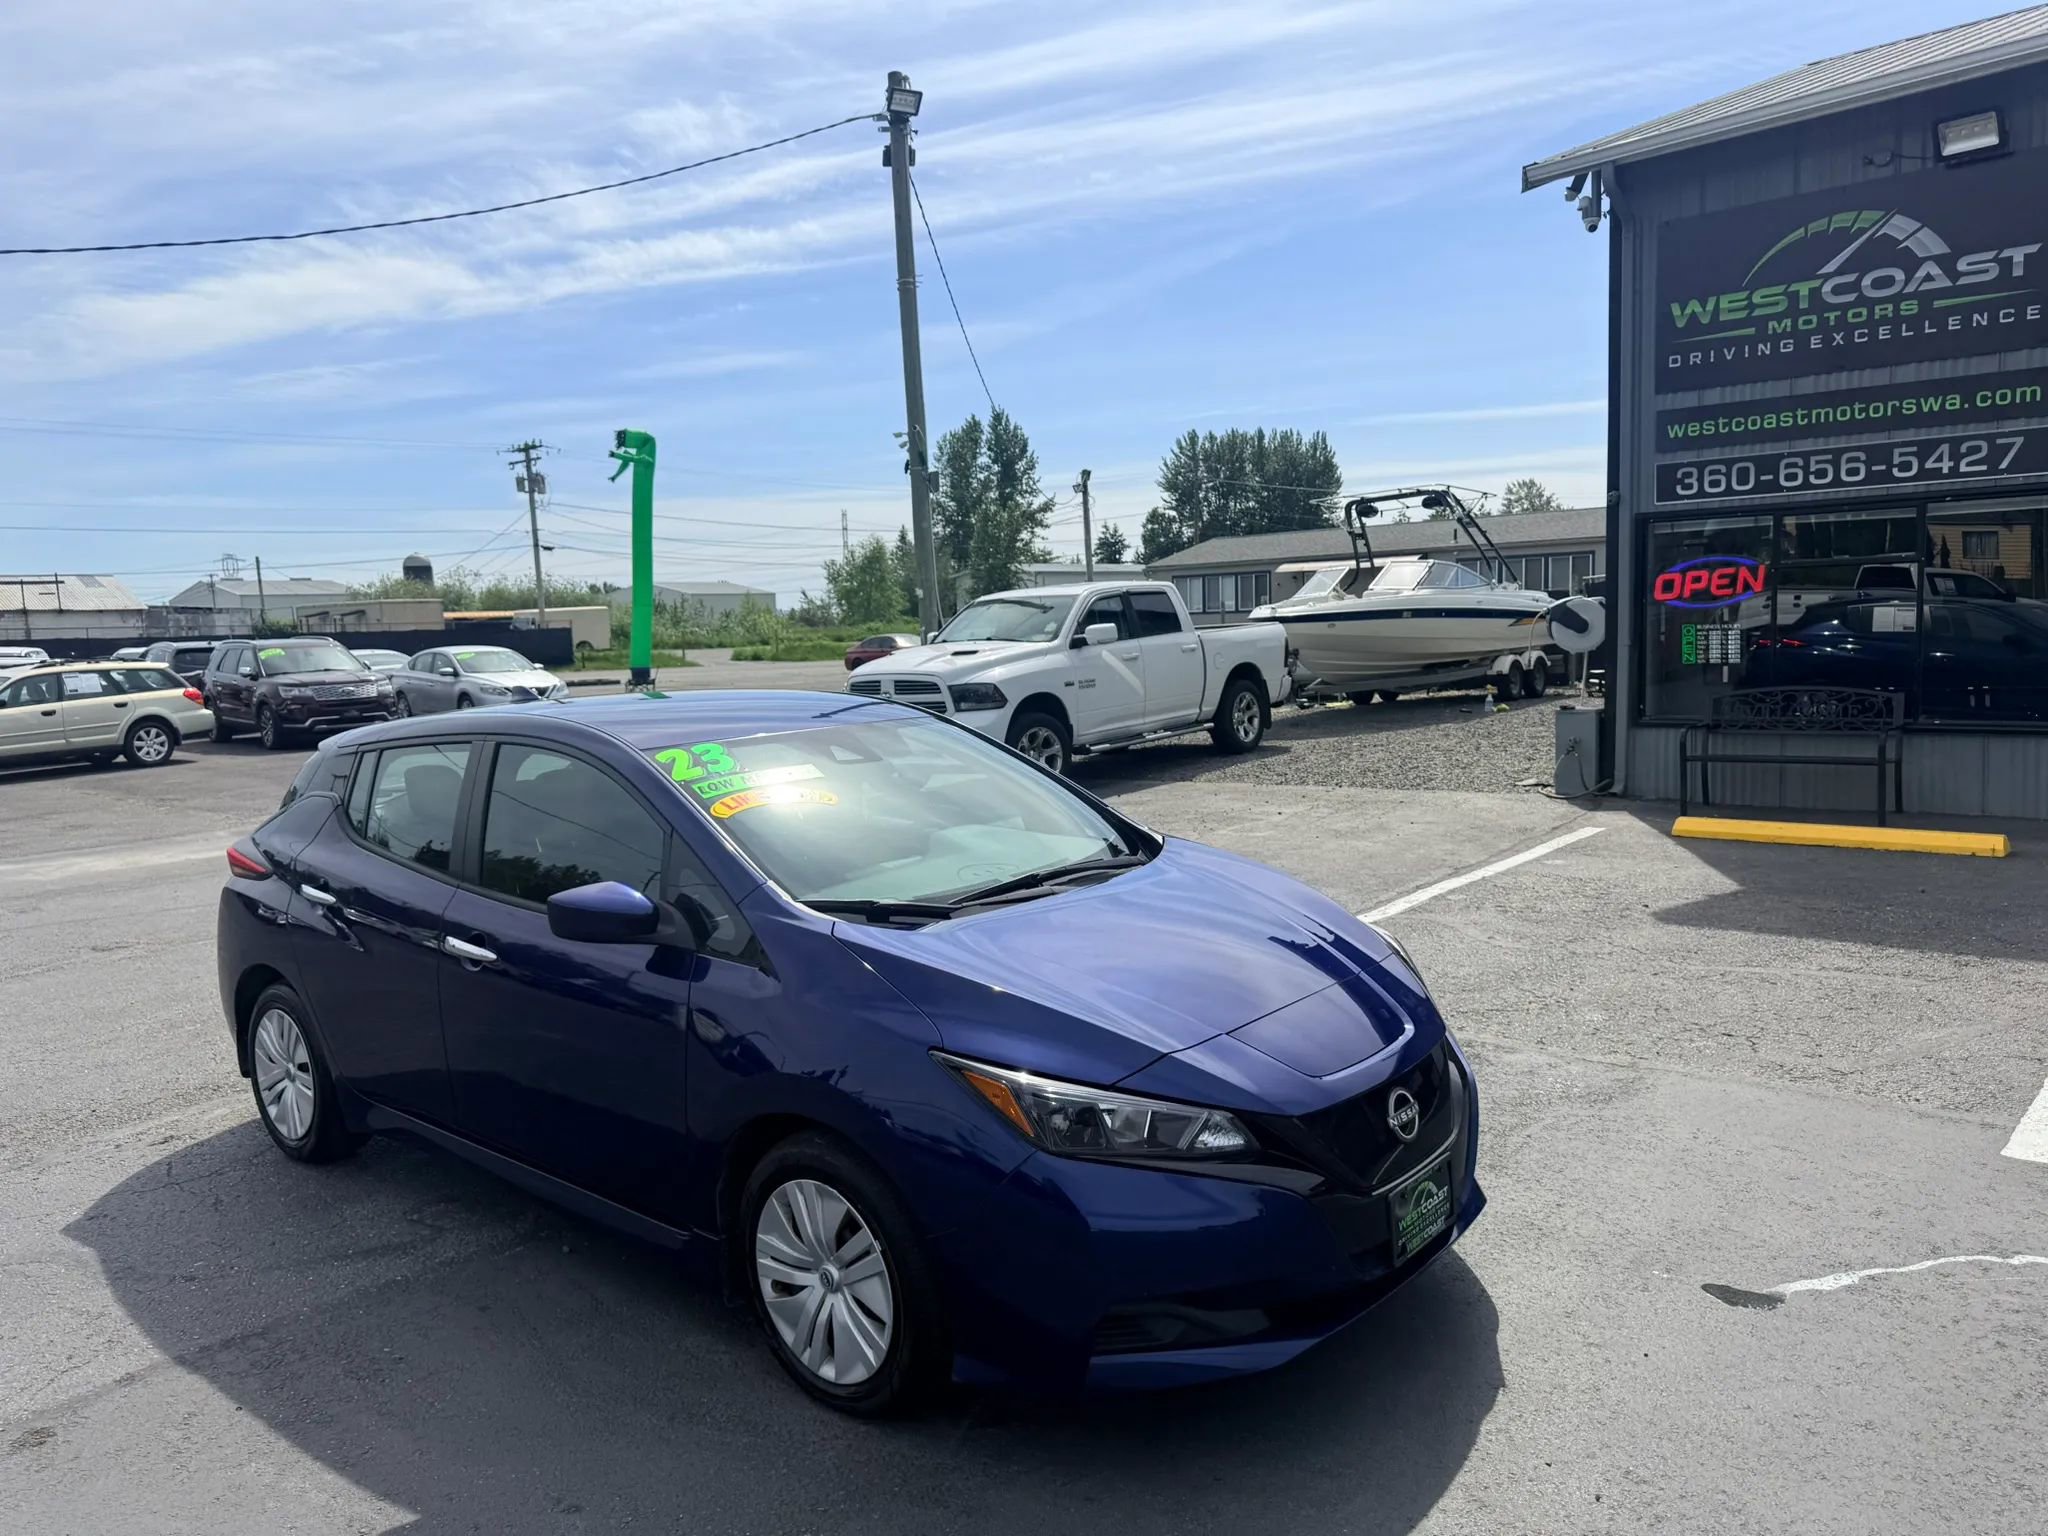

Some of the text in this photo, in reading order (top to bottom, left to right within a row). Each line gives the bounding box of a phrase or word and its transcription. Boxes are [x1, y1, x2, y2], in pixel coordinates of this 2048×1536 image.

[1669, 305, 2041, 368] DRIVING EXCELLENCE
[1768, 300, 1918, 335] MOTORS
[1667, 385, 2041, 439] westcoastmotorswa.com
[1675, 436, 2025, 496] 360-656-5427
[1653, 565, 1766, 601] OPEN
[655, 743, 736, 782] 23
[699, 778, 734, 795] LOW
